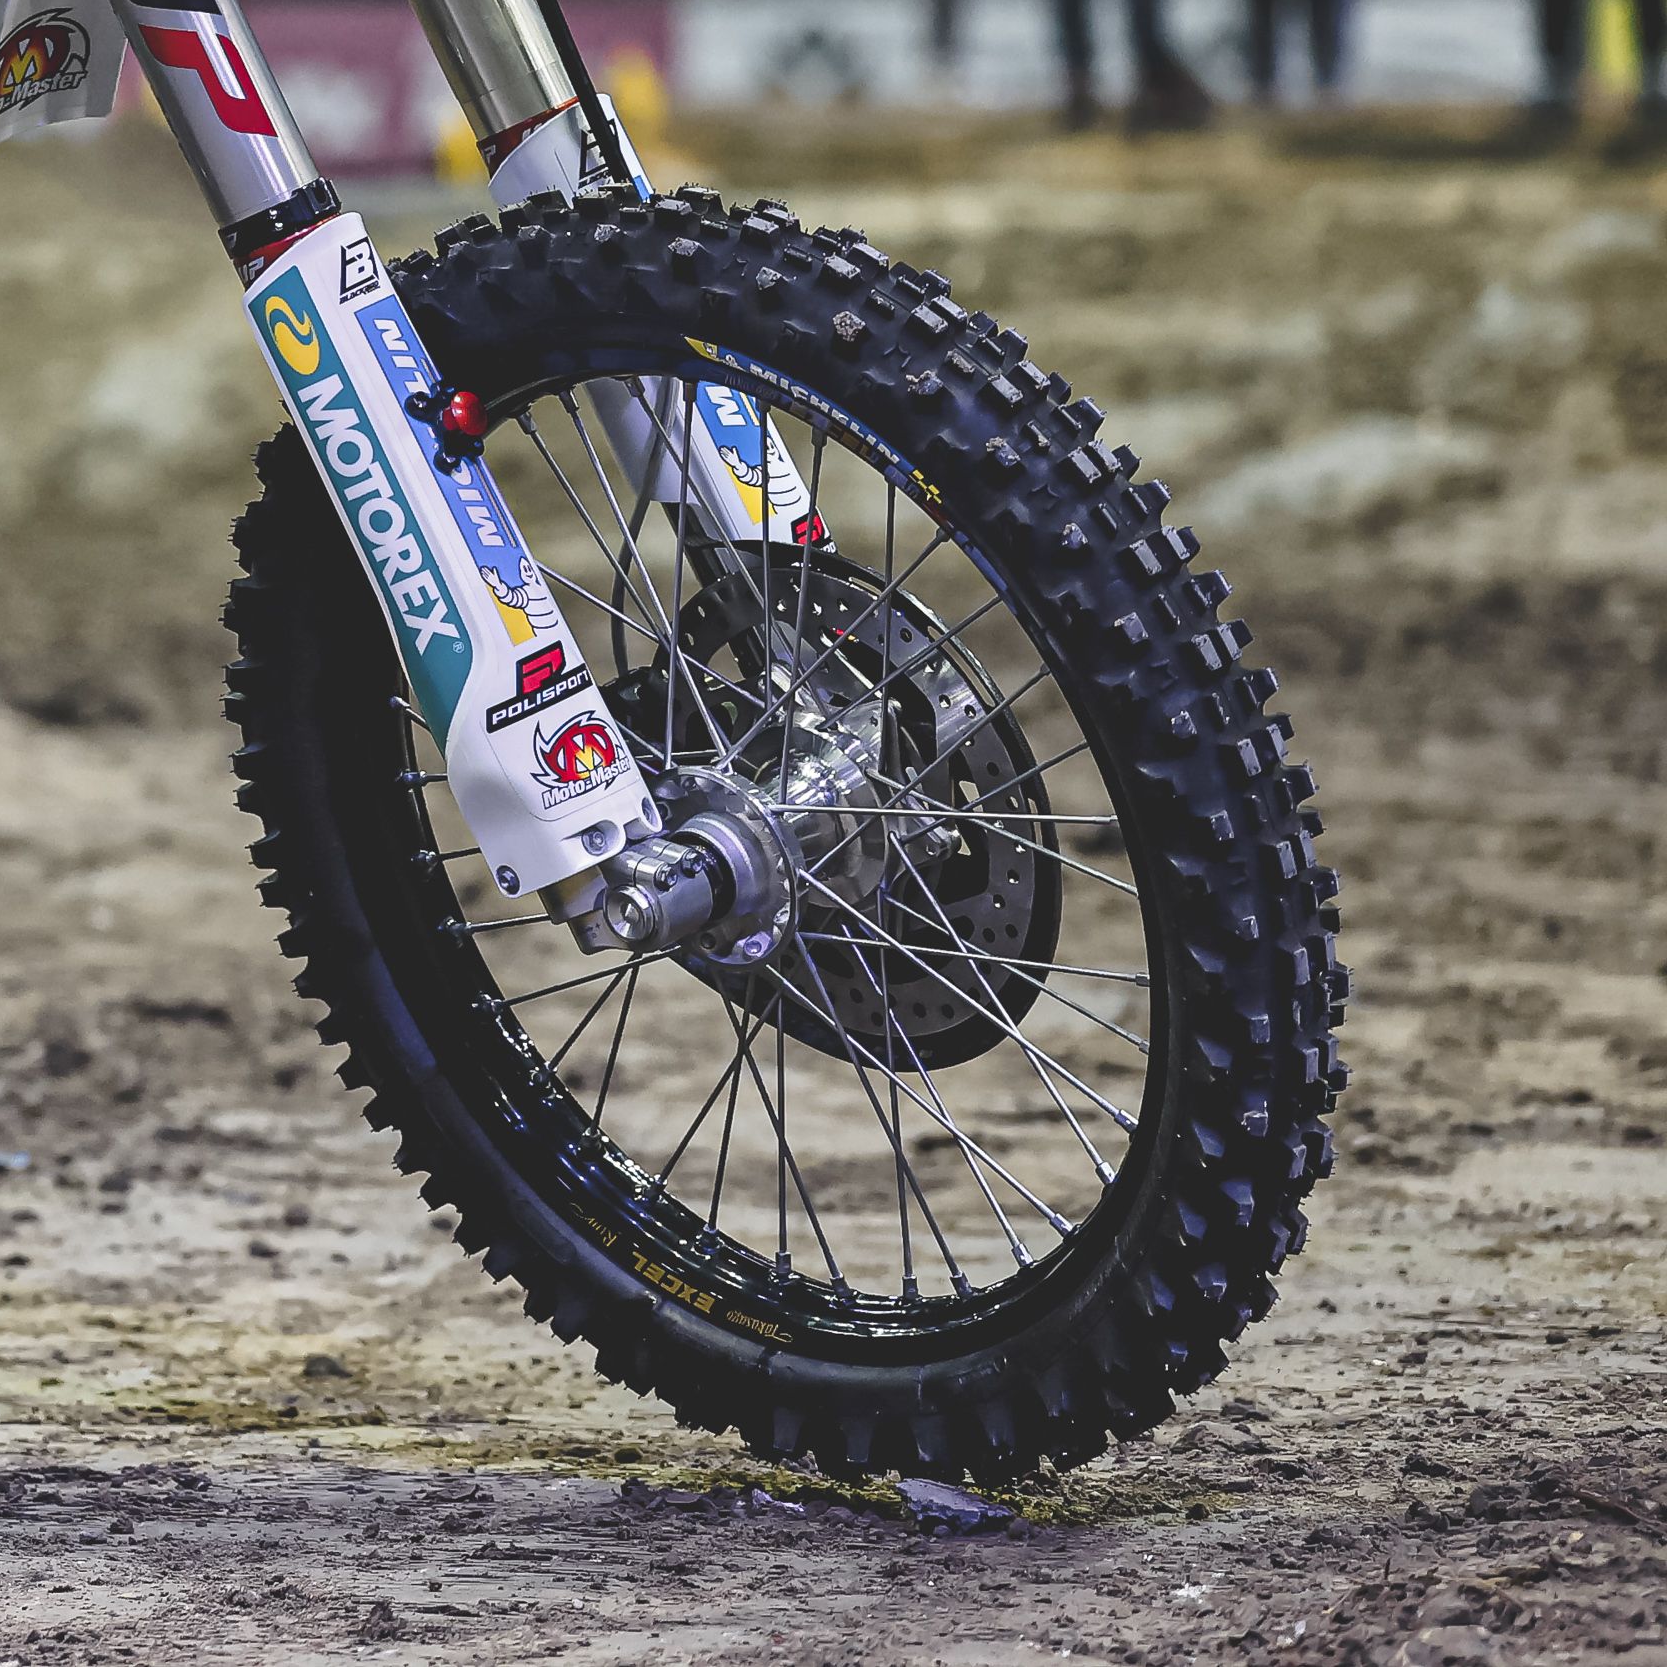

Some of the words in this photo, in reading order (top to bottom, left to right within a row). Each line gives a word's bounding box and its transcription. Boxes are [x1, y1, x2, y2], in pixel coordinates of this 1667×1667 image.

[296, 372, 462, 656] MOTOREX
[492, 669, 589, 725] POLISPORT
[632, 1250, 716, 1315] EXCEL
